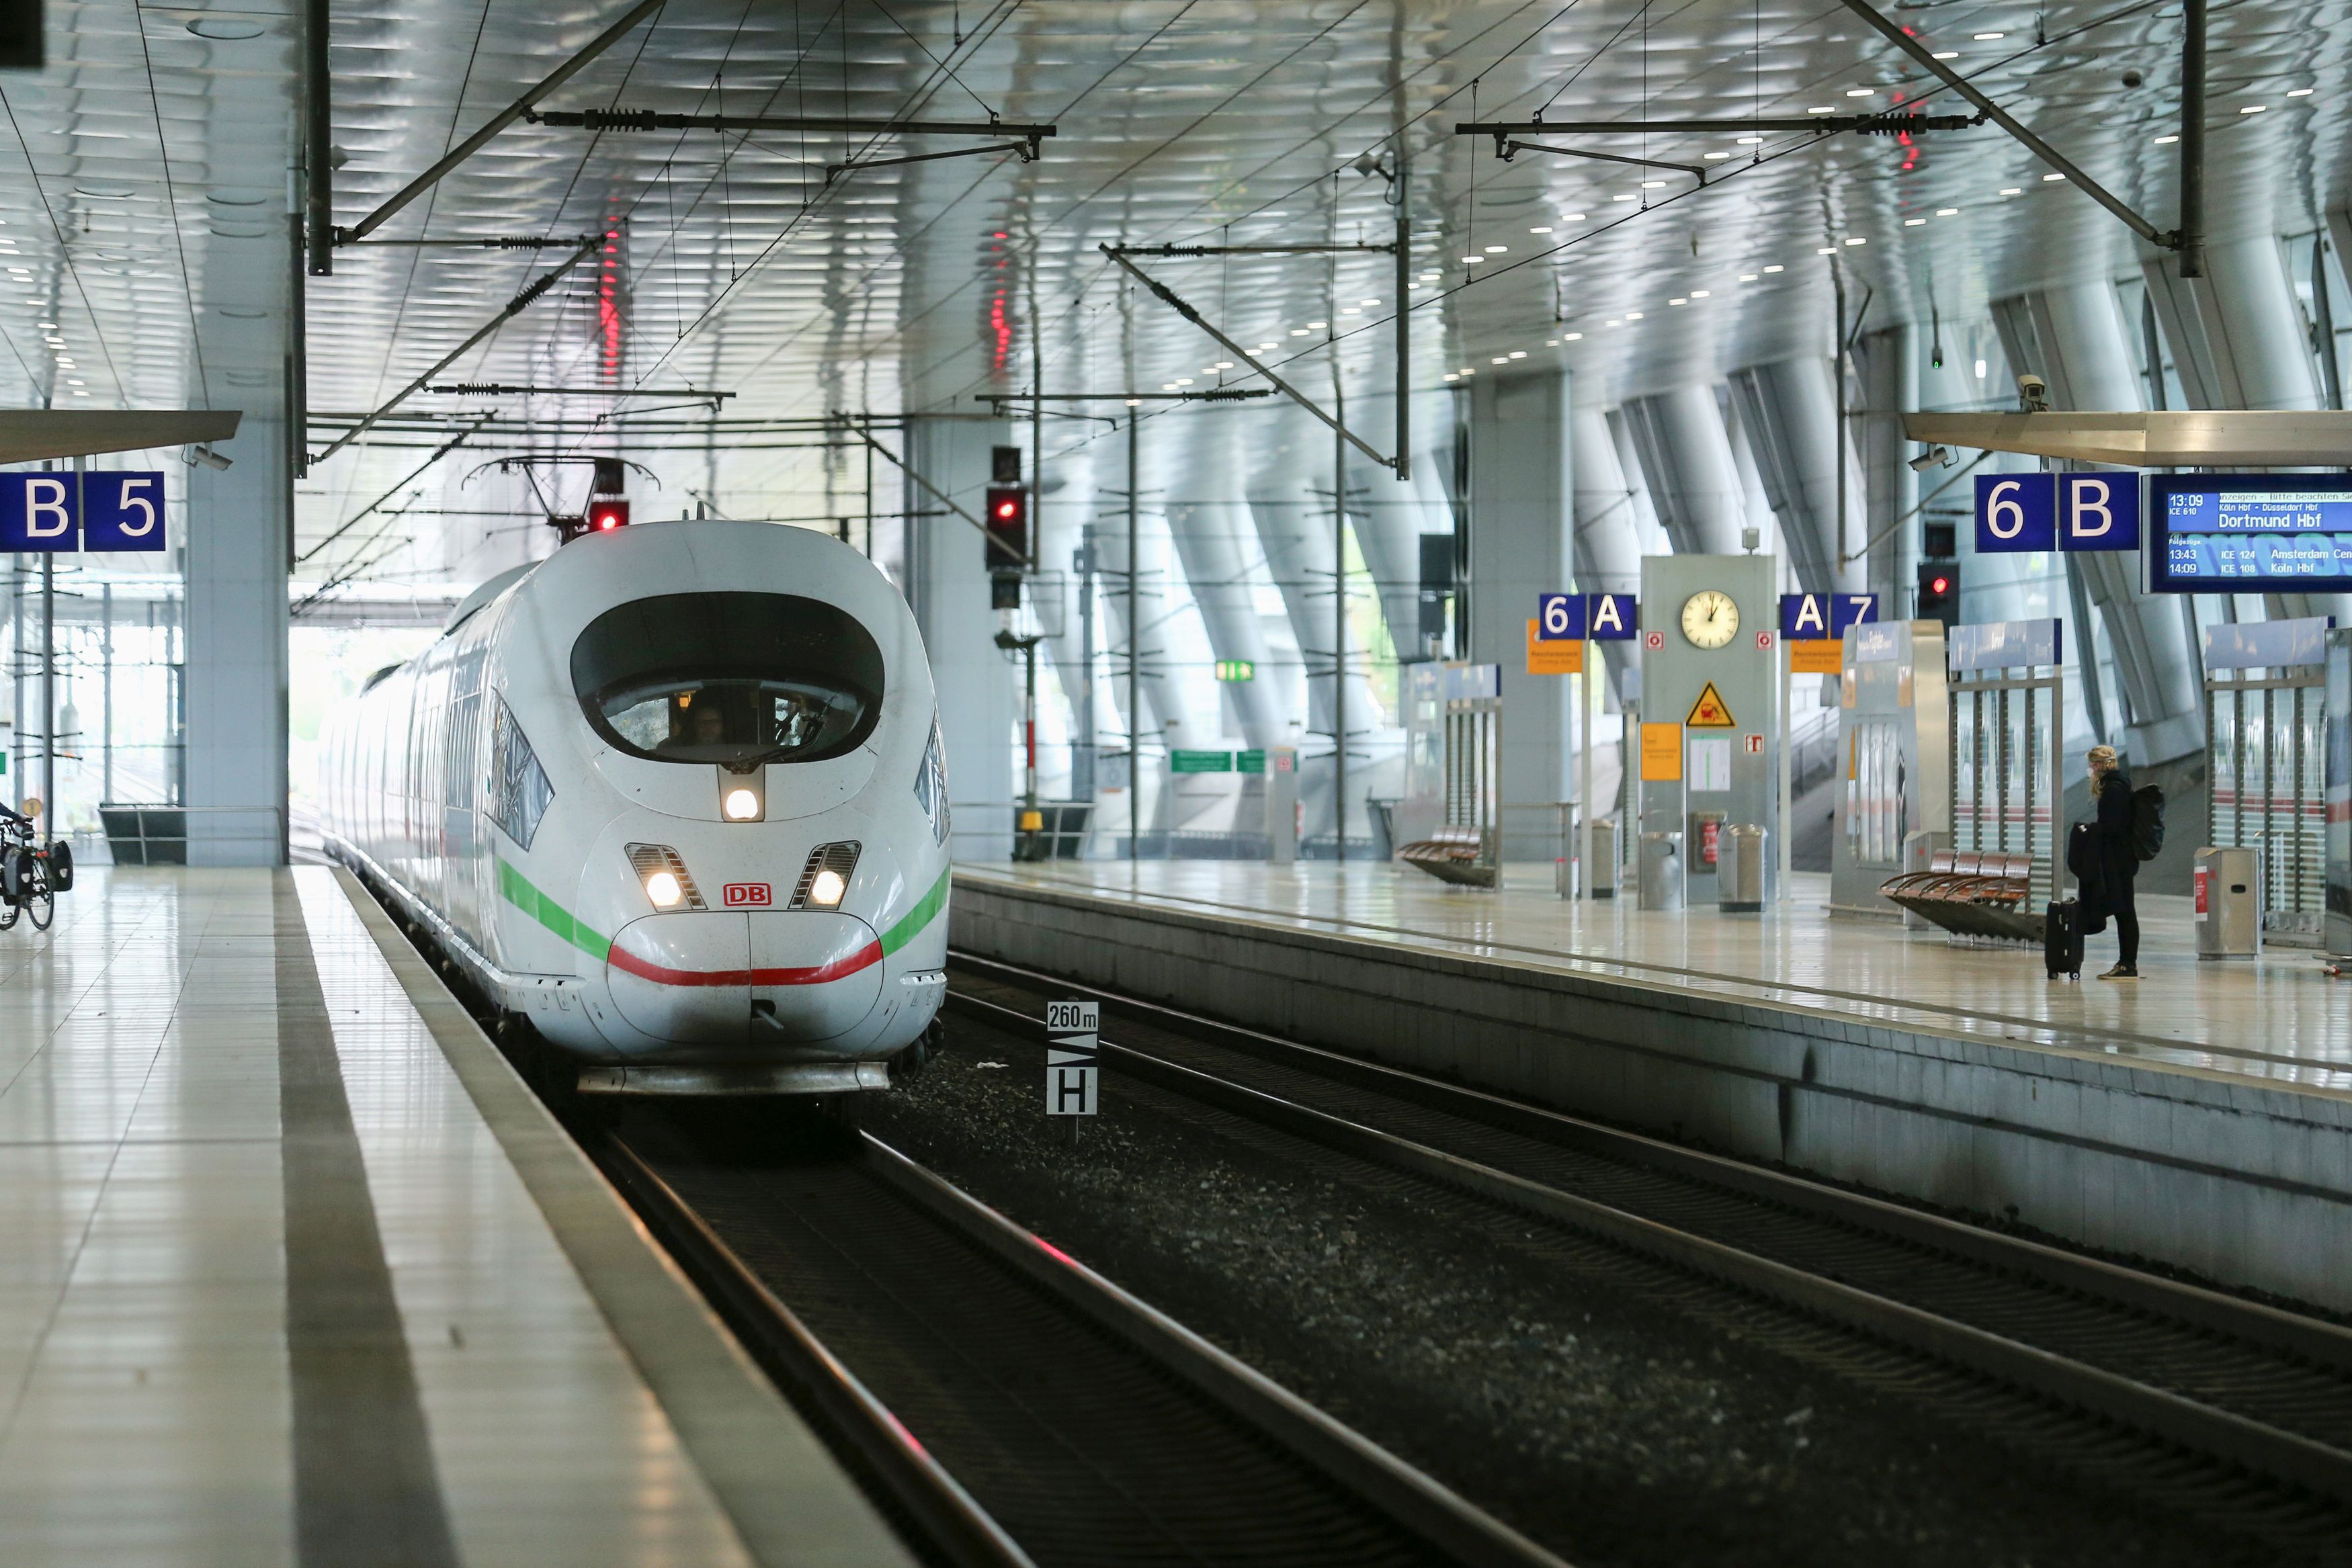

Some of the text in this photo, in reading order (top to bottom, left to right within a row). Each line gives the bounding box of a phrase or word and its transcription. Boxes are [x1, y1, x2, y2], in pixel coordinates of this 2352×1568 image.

[2170, 494, 2203, 507] 13:09
[2220, 493, 2257, 501] nzeigen
[26, 479, 155, 537] B 5
[1987, 479, 2112, 539] 6 B
[2219, 503, 2236, 511] Köln
[2238, 503, 2251, 511] Hbf
[2262, 503, 2303, 511] Düsseldorf
[2305, 503, 2318, 511] Hbf
[2219, 513, 2322, 527] Dortmund Hbf
[2169, 549, 2197, 560] 13:43
[2221, 550, 2235, 559] ICE
[2239, 550, 2255, 559] 124
[2271, 549, 2328, 559] Amsterdam
[2169, 562, 2315, 574] 14:09 ICE 108 Köln Hbf
[1545, 595, 1624, 634] 6 A
[1794, 594, 1872, 631] A 7
[729, 885, 767, 903] DB
[1049, 1005, 1096, 1028] 260 m
[1058, 1069, 1086, 1113] H
